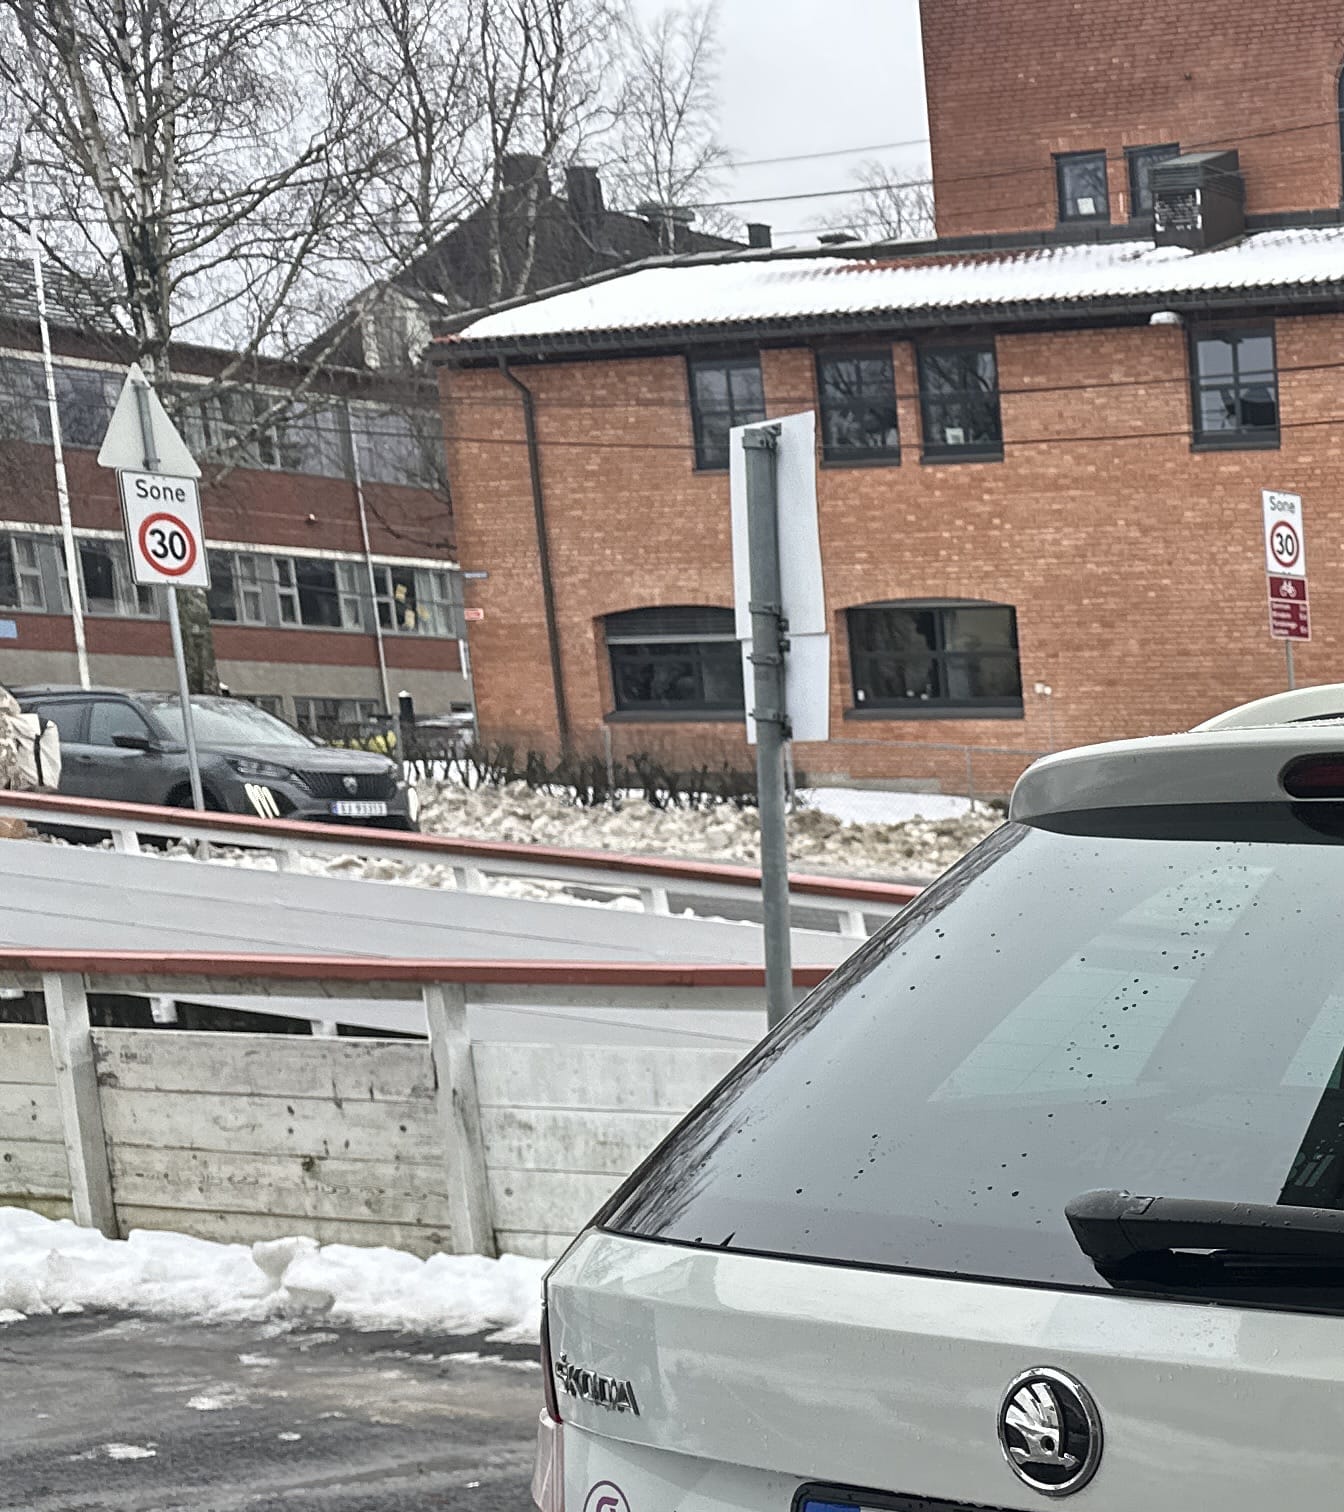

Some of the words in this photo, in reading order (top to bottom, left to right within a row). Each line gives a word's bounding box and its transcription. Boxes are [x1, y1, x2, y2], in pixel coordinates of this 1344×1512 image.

[135, 479, 186, 502] Sone
[1269, 495, 1296, 514] Sone
[149, 528, 186, 561] 30
[1276, 533, 1295, 557] 30
